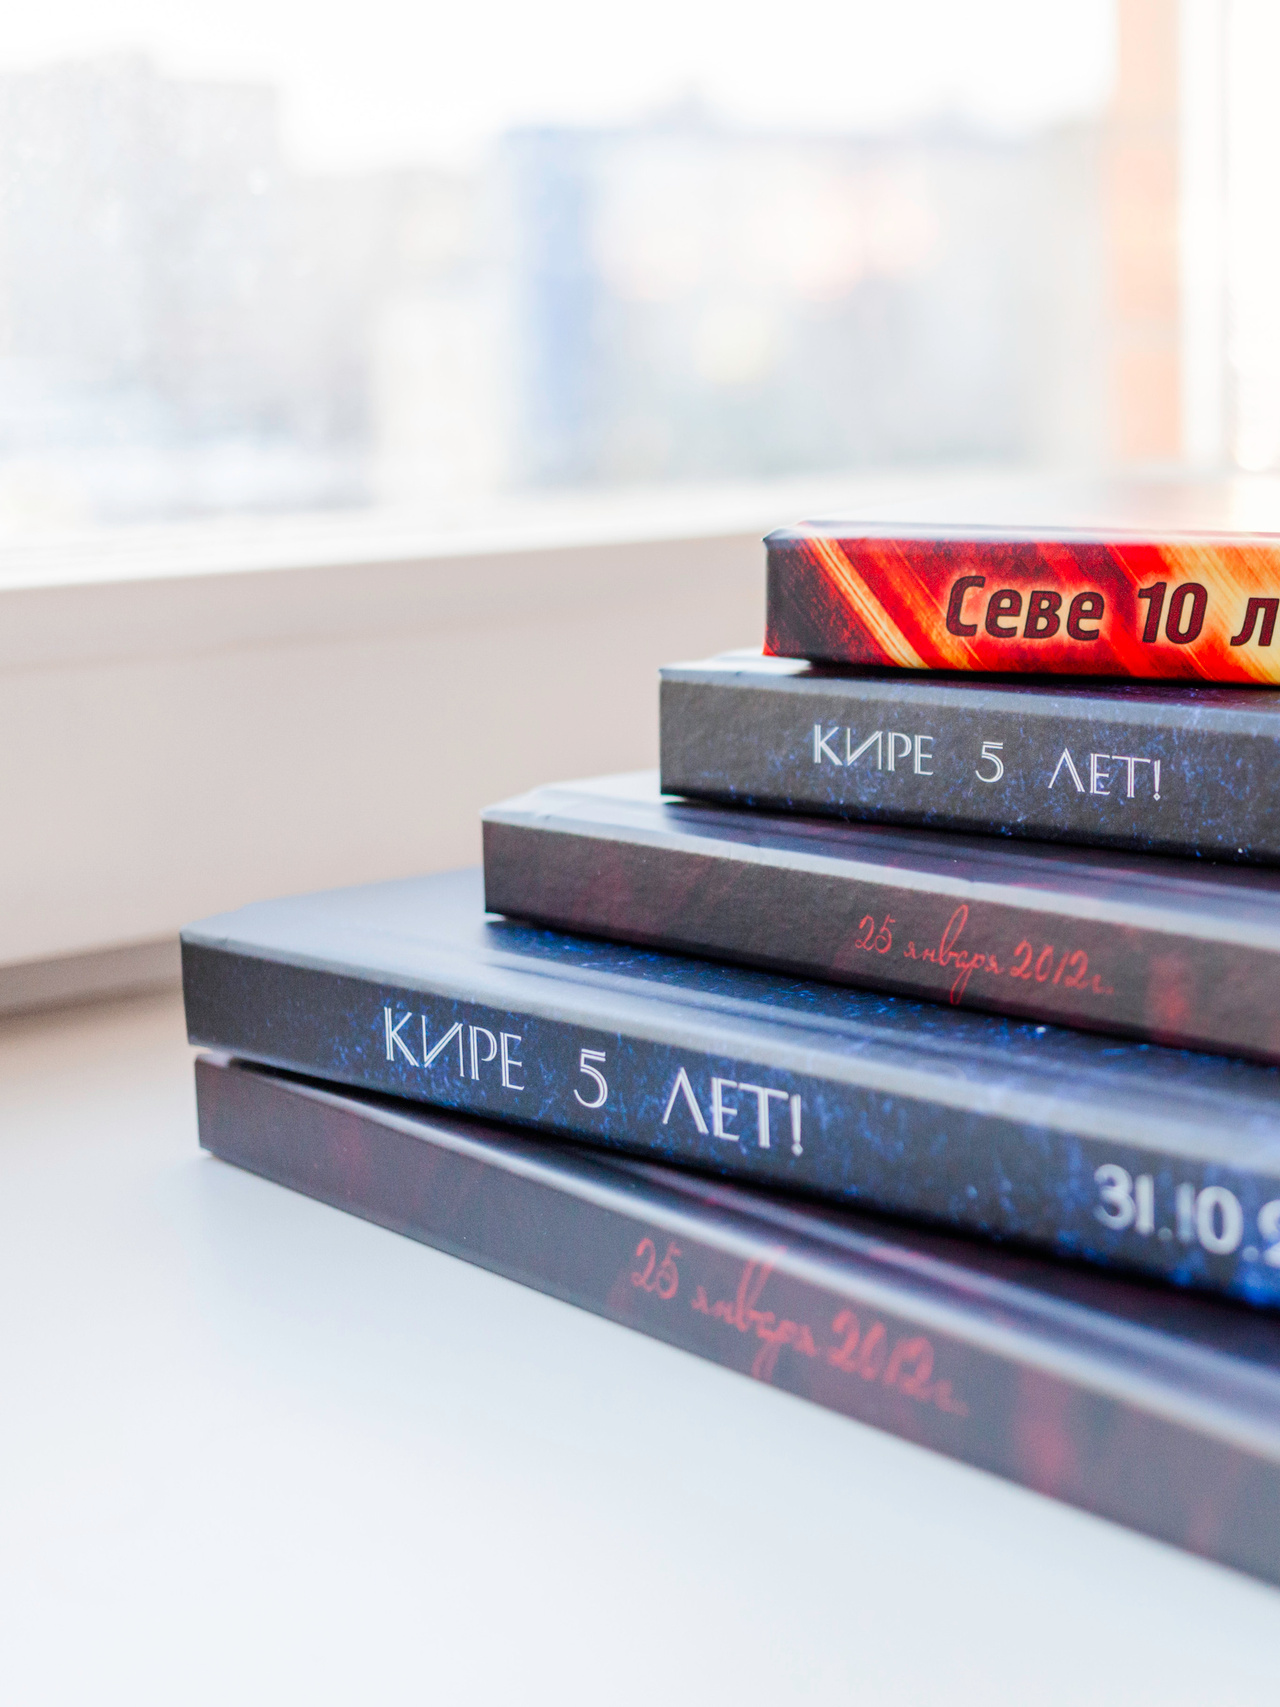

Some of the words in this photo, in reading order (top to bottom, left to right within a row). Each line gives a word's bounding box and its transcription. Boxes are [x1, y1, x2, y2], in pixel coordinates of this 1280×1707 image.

[945, 575, 1105, 642] Севе
[1137, 581, 1208, 644] 10
[812, 723, 934, 776] КИРЕ
[975, 741, 1004, 783] 5
[1048, 747, 1162, 801] ЛЕТ!
[854, 914, 896, 954] 25
[903, 904, 1001, 1006] января
[383, 1006, 525, 1091] КИРЕ
[574, 1048, 608, 1109] 5
[662, 1066, 803, 1156] ЛЕТ!
[631, 1237, 682, 1299] 25
